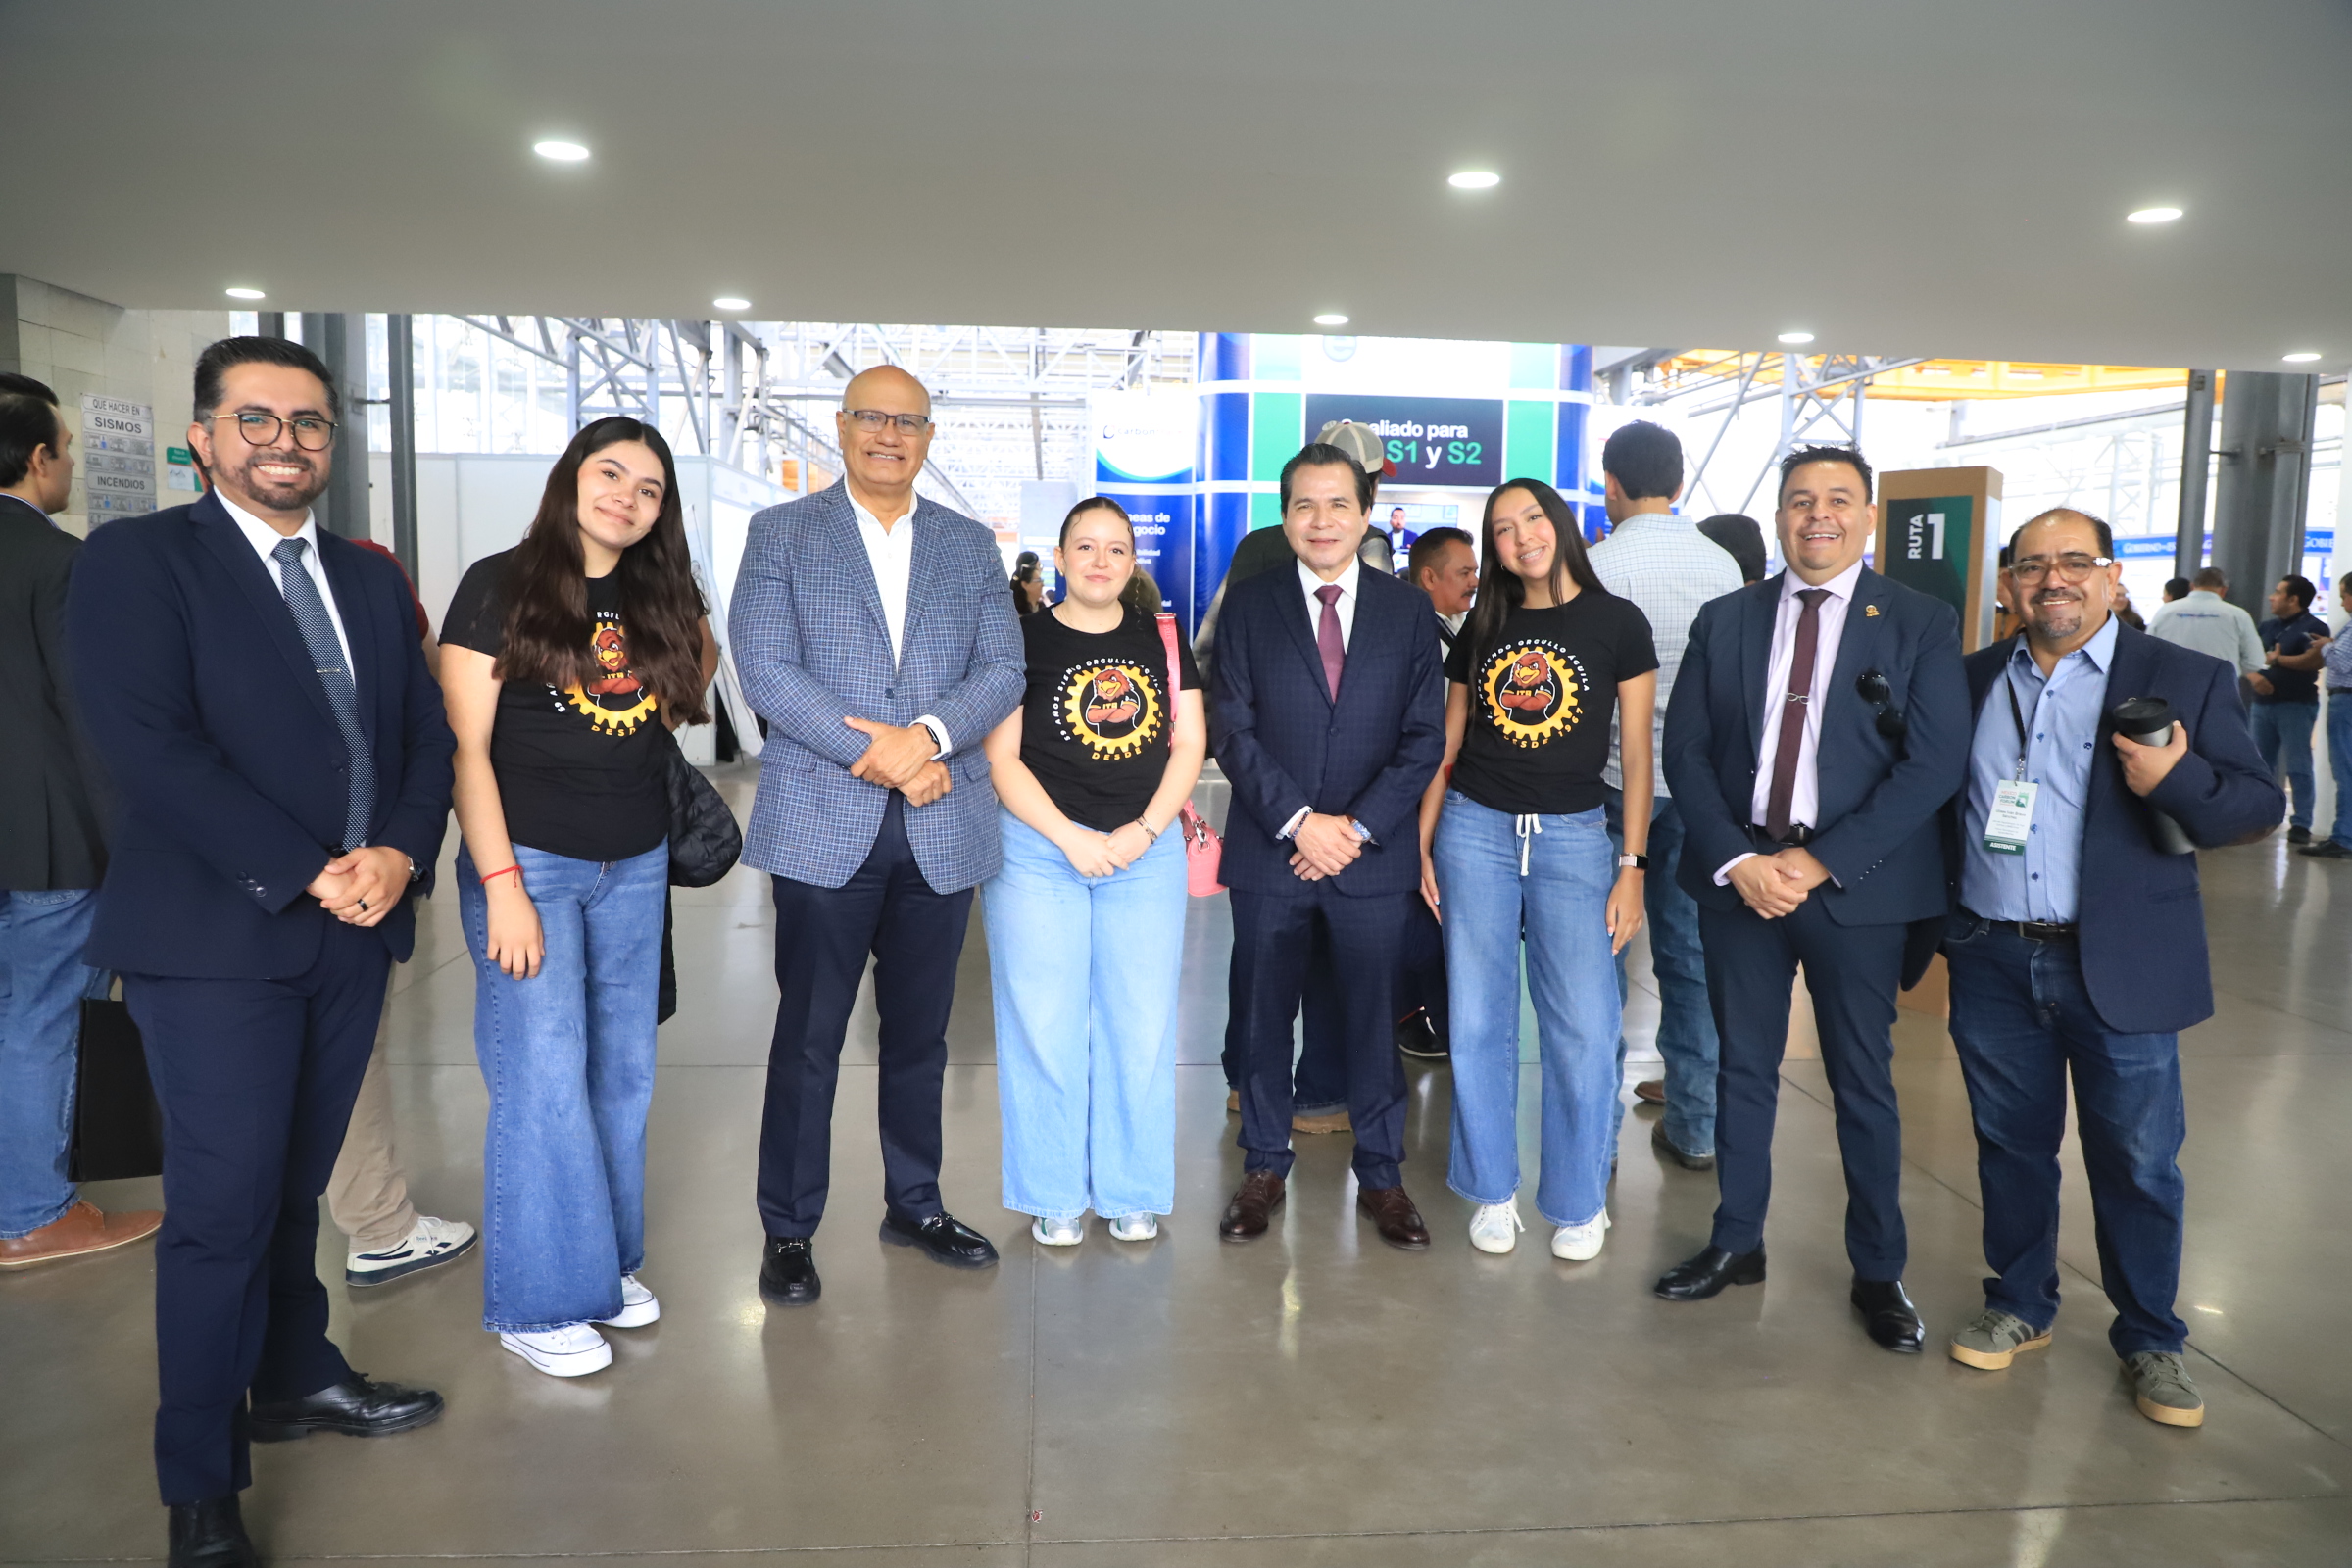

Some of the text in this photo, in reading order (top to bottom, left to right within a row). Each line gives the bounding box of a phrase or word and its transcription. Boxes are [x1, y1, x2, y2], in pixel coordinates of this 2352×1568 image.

[93, 399, 140, 416] QUE HACER EN
[94, 416, 142, 434] SISMOS
[1427, 424, 1468, 441] para
[1386, 439, 1482, 469] S1 y S2
[97, 476, 145, 490] INCENDIOS
[1155, 511, 1170, 523] de
[1907, 514, 1924, 559] RUTA
[1927, 513, 1945, 559] 1
[1518, 639, 1566, 653] ORGULLO
[1568, 655, 1590, 692] ÁGUILA
[554, 702, 566, 712] 59
[1059, 729, 1071, 742] 59
[1086, 658, 1135, 666] ORGULLO
[1558, 707, 1583, 737] 1967
[1092, 747, 1142, 760] DESDE
[1989, 842, 2017, 852] ASISTENTE
